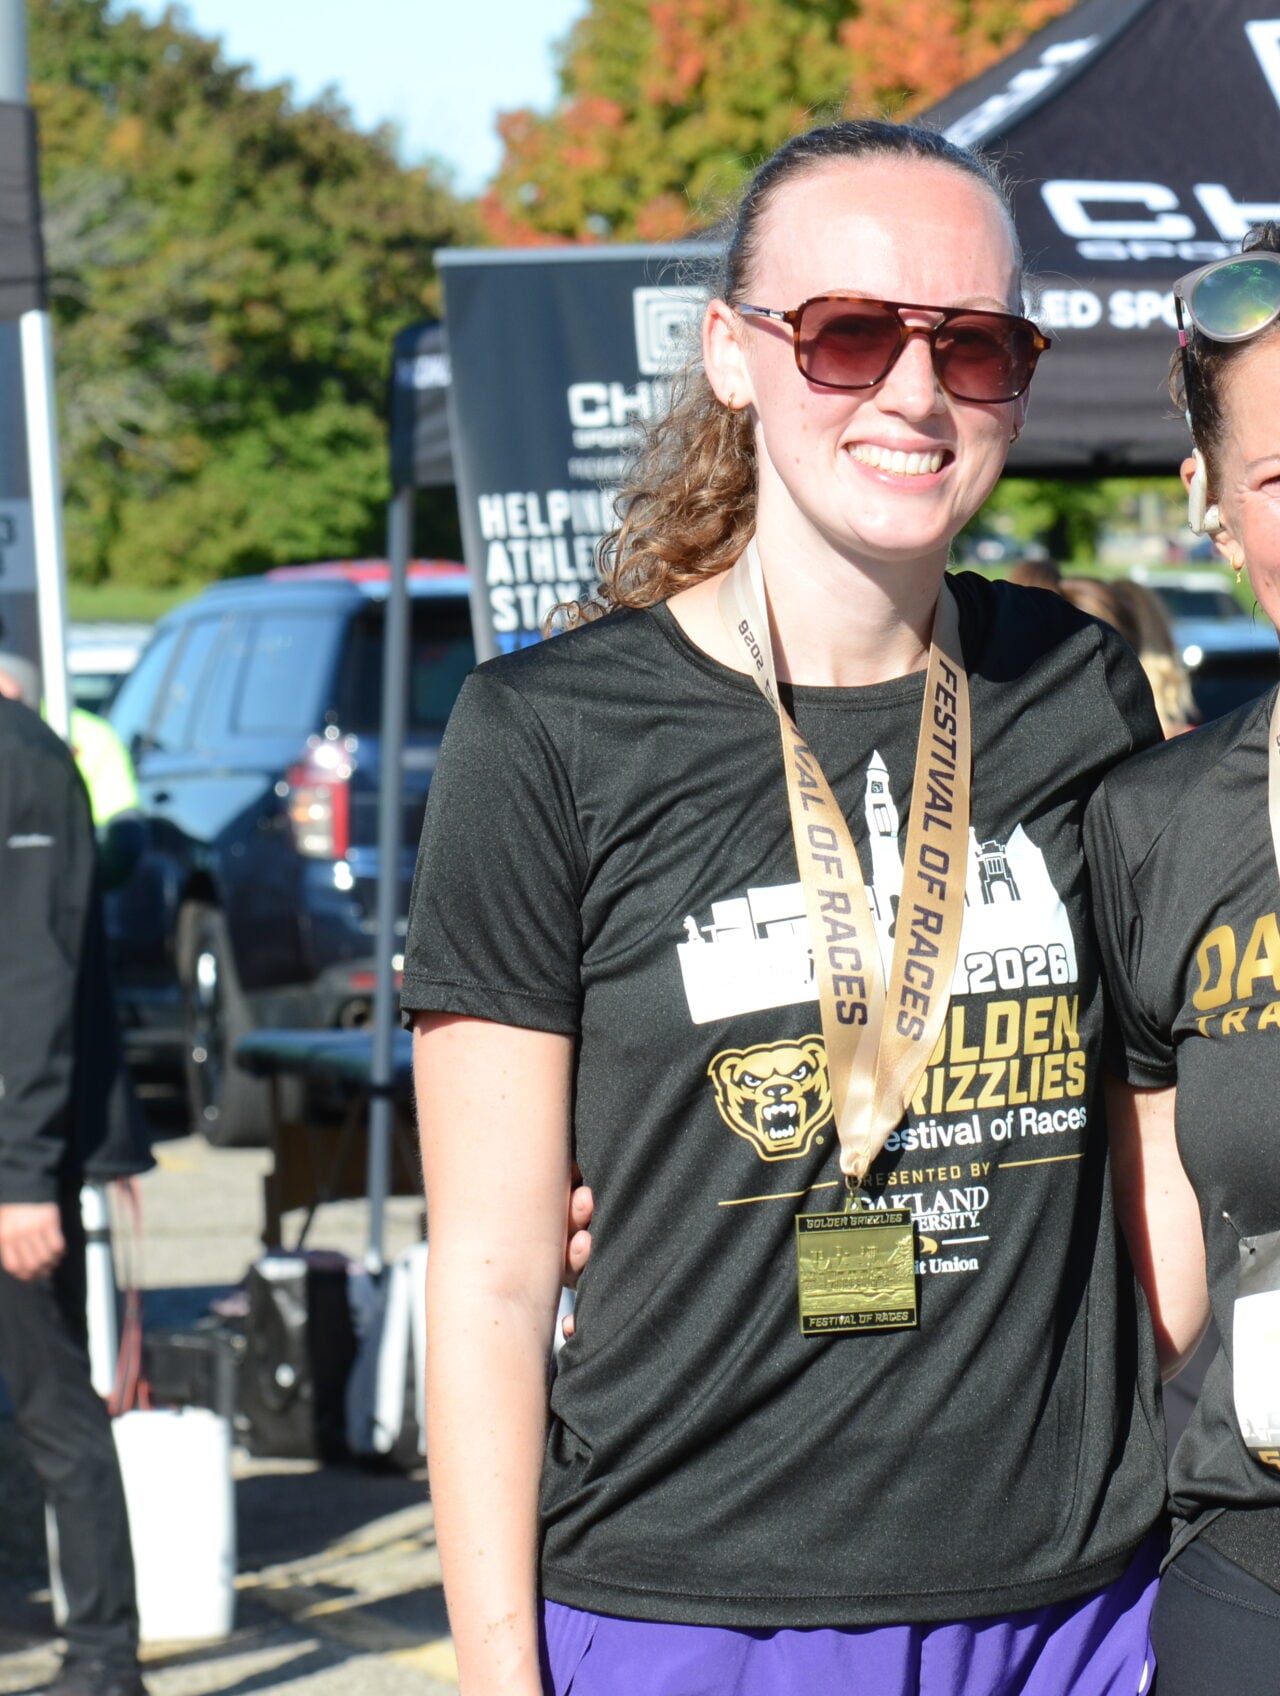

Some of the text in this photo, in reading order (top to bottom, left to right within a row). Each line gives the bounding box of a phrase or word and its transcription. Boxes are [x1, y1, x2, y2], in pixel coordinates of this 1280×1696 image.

[1109, 289, 1194, 329] SPO
[486, 535, 599, 587] ATHLE
[738, 619, 764, 671] 2026
[807, 824, 843, 879] OF
[896, 658, 958, 1042] FESTIVAL OF RACES
[817, 889, 868, 1026] RACES
[964, 943, 1069, 994] 2026
[911, 1051, 1087, 1116] RIZZLIES
[884, 1107, 1087, 1151] estival of Races
[971, 1162, 991, 1177] BY
[806, 1213, 903, 1229] GOLDEN GRIZZLIES
[913, 1211, 980, 1232] ERSITY.
[929, 1256, 979, 1275] Union
[809, 1311, 909, 1328] FESTIVAL OF RACES
